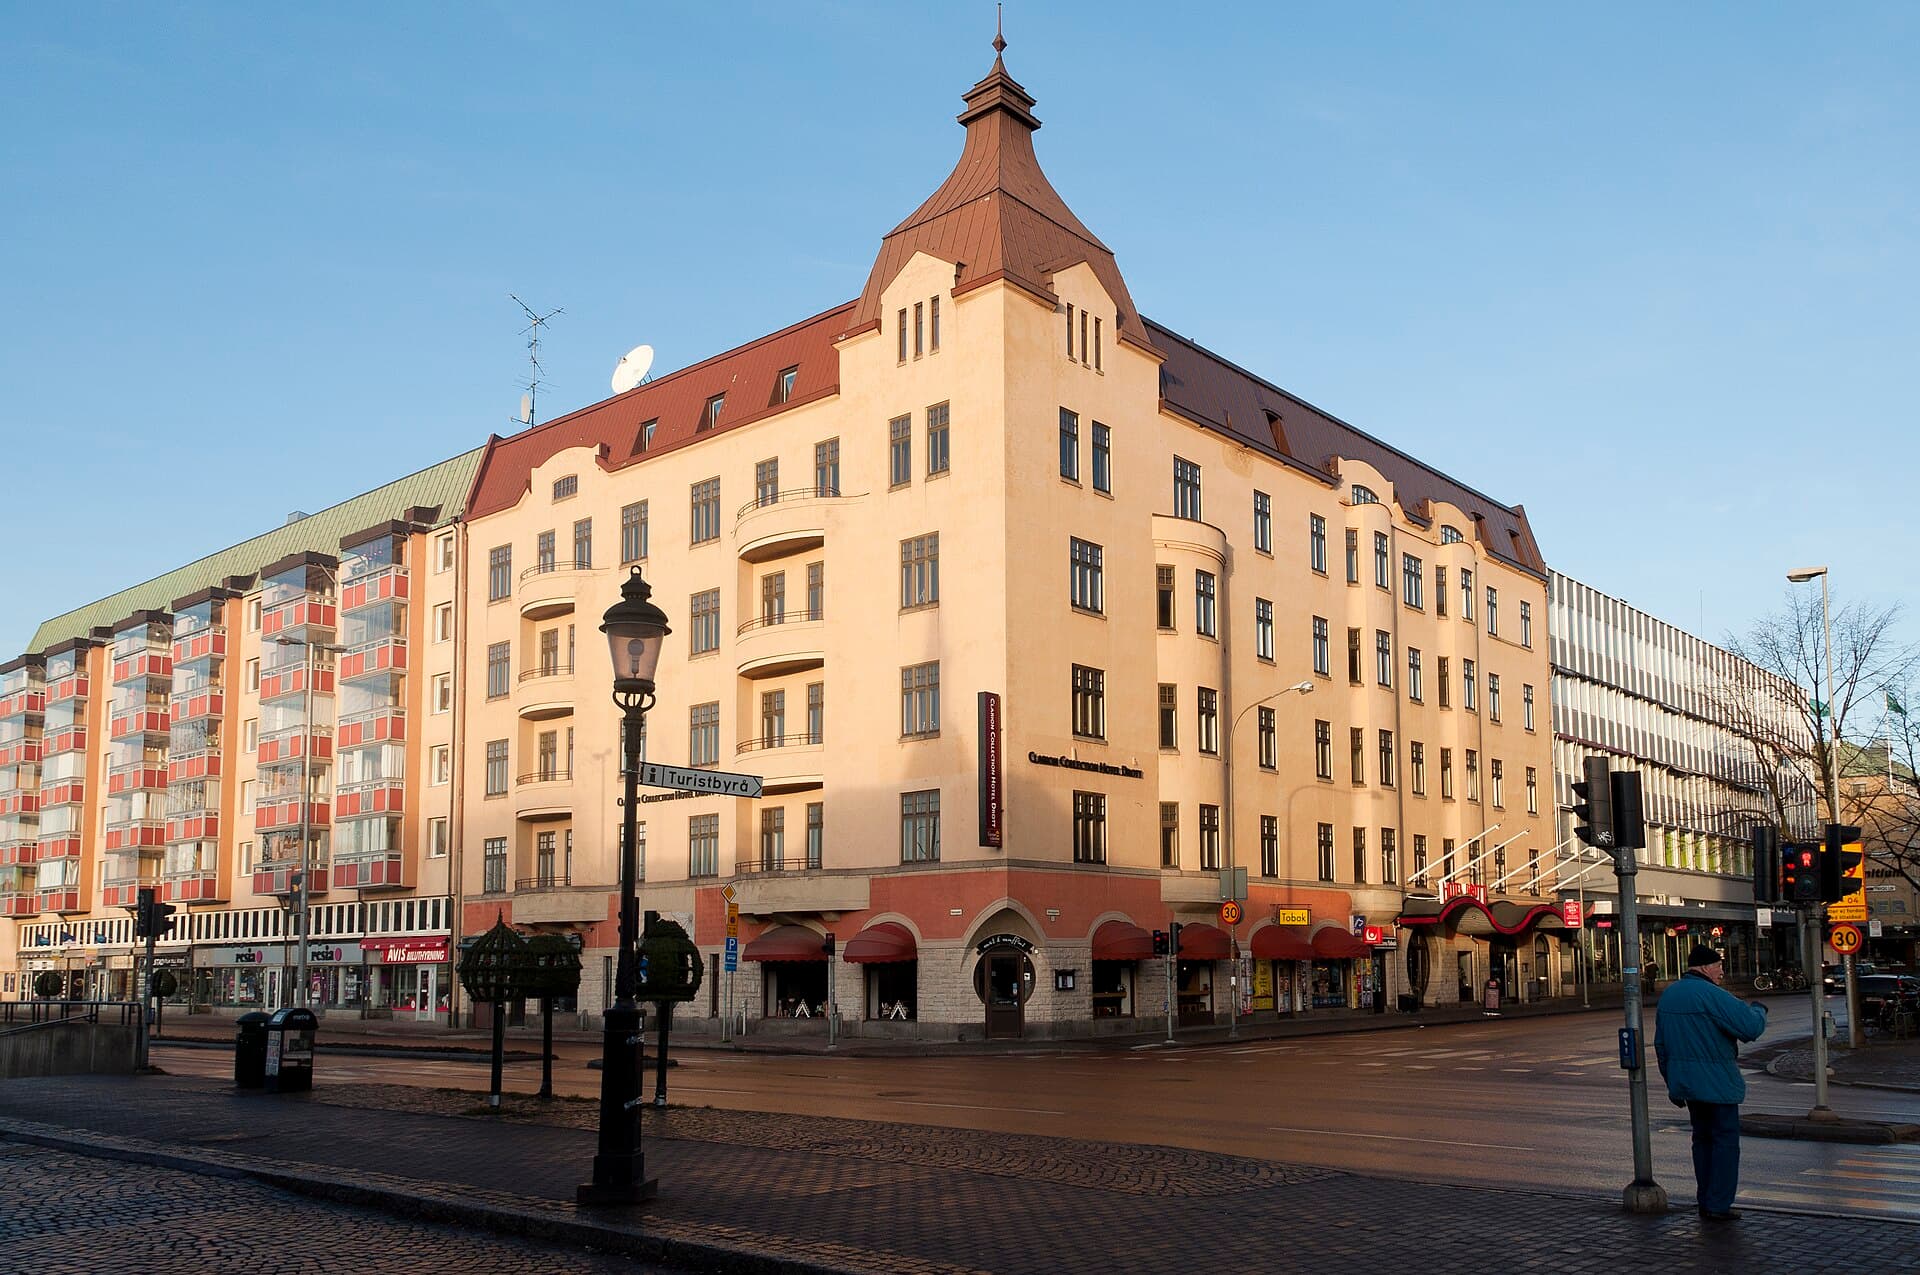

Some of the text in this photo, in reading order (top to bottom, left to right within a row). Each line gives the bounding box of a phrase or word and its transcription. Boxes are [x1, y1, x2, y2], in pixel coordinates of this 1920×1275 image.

[668, 771, 749, 793] Turistbyrå
[1224, 906, 1237, 919] 30
[1281, 912, 1307, 922] Tobak
[1834, 931, 1857, 947] 30
[311, 945, 334, 961] resia
[387, 948, 445, 961] AVIS BILUTHYRNING
